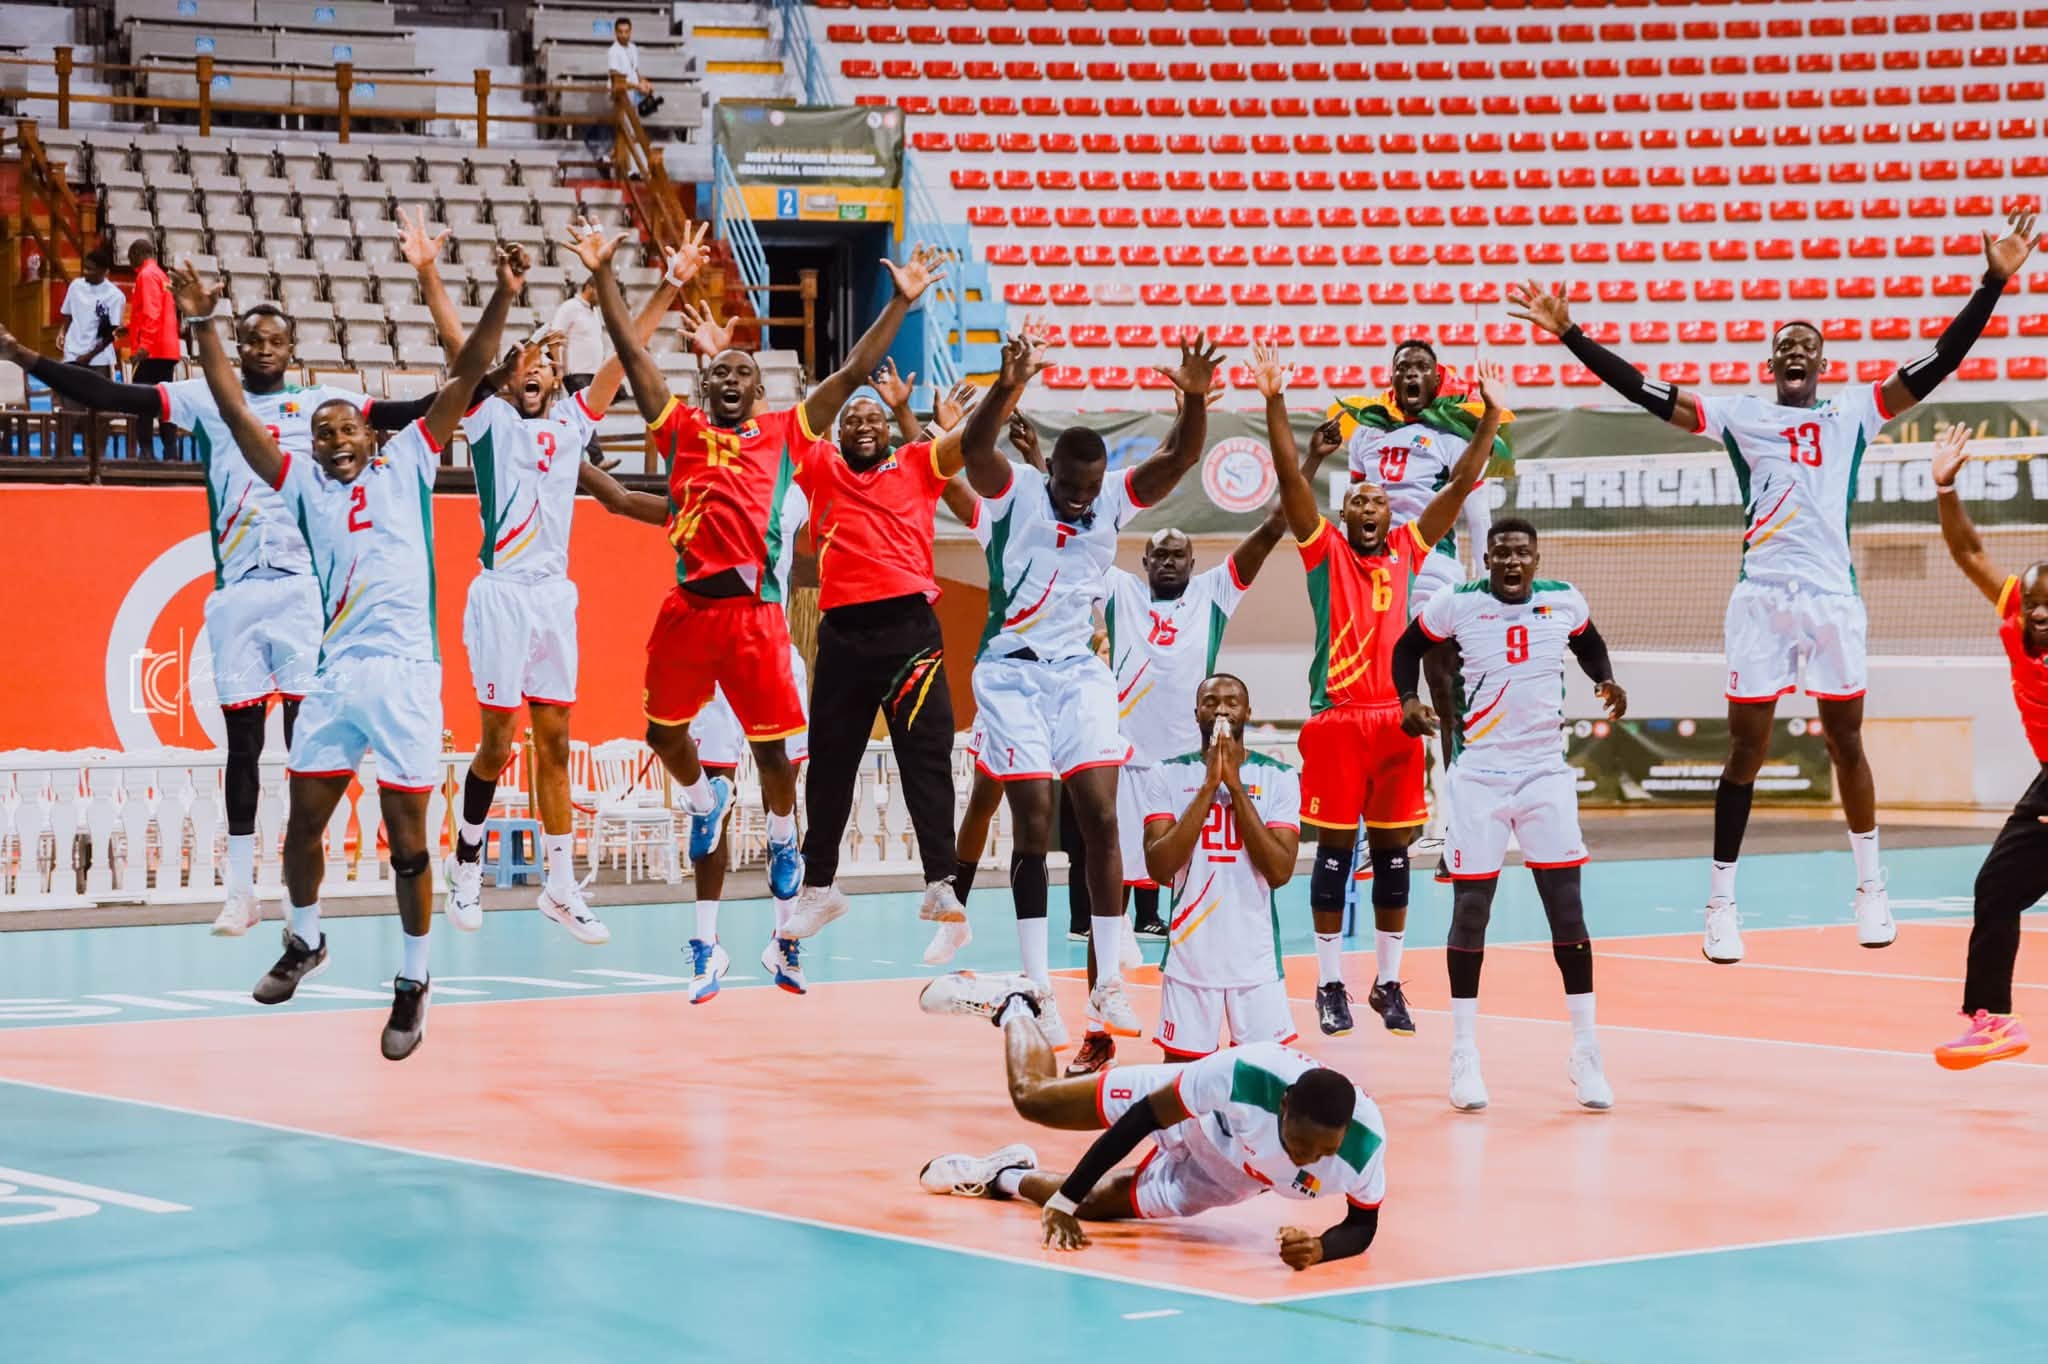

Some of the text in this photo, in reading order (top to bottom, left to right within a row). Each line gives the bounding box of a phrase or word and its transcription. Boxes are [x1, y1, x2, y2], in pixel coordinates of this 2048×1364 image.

[783, 191, 793, 214] 2
[537, 431, 556, 472] 3
[1779, 422, 1822, 467] 13
[1378, 446, 1410, 482] 19
[1856, 459, 2018, 503] TIONS
[348, 486, 373, 533] 2
[1371, 568, 1392, 612] 6
[1148, 610, 1178, 646] 15
[1506, 624, 1529, 664] 9
[487, 683, 495, 700] 3
[1006, 748, 1015, 768] 7
[1310, 796, 1320, 815] 6
[1201, 803, 1243, 851] 20
[1454, 849, 1461, 869] 9
[1163, 1020, 1175, 1041] 20
[1110, 1088, 1132, 1100] 8
